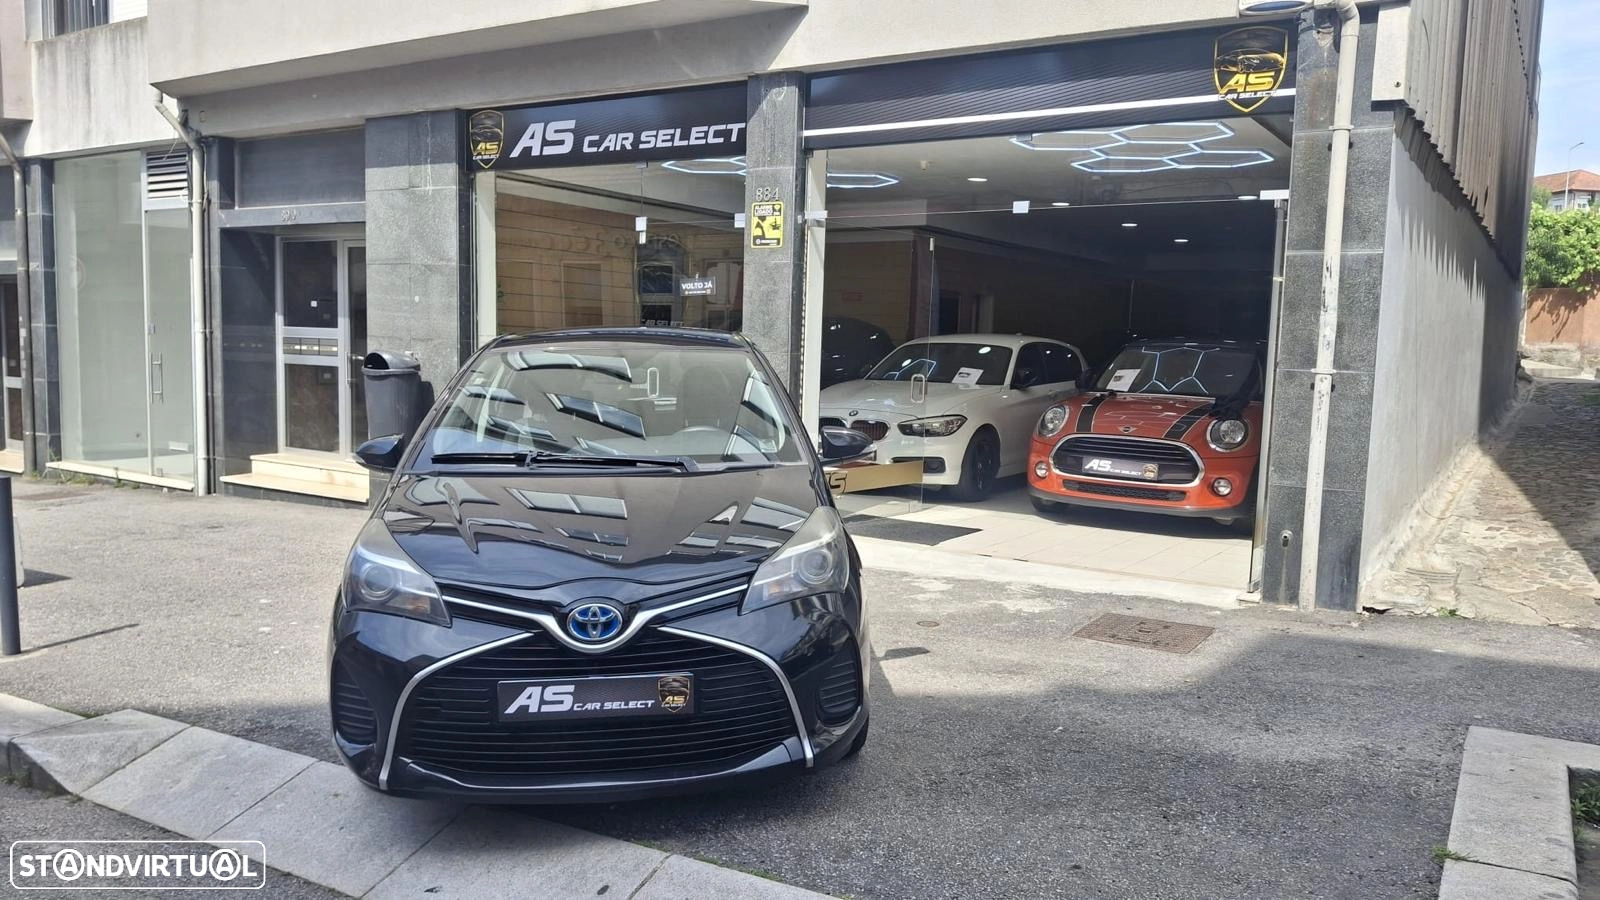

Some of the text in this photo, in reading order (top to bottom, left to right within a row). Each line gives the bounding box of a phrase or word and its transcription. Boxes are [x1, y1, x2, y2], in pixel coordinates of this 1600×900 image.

[1219, 71, 1275, 94] AS
[509, 119, 746, 158] AS CAR SELECT
[474, 142, 499, 155] AS
[756, 187, 779, 201] 884
[681, 280, 713, 290] VOLTO JÁ
[1084, 459, 1113, 472] AS
[825, 470, 848, 493] S
[504, 684, 655, 714] AS CAR SELECT
[662, 695, 686, 705] AS
